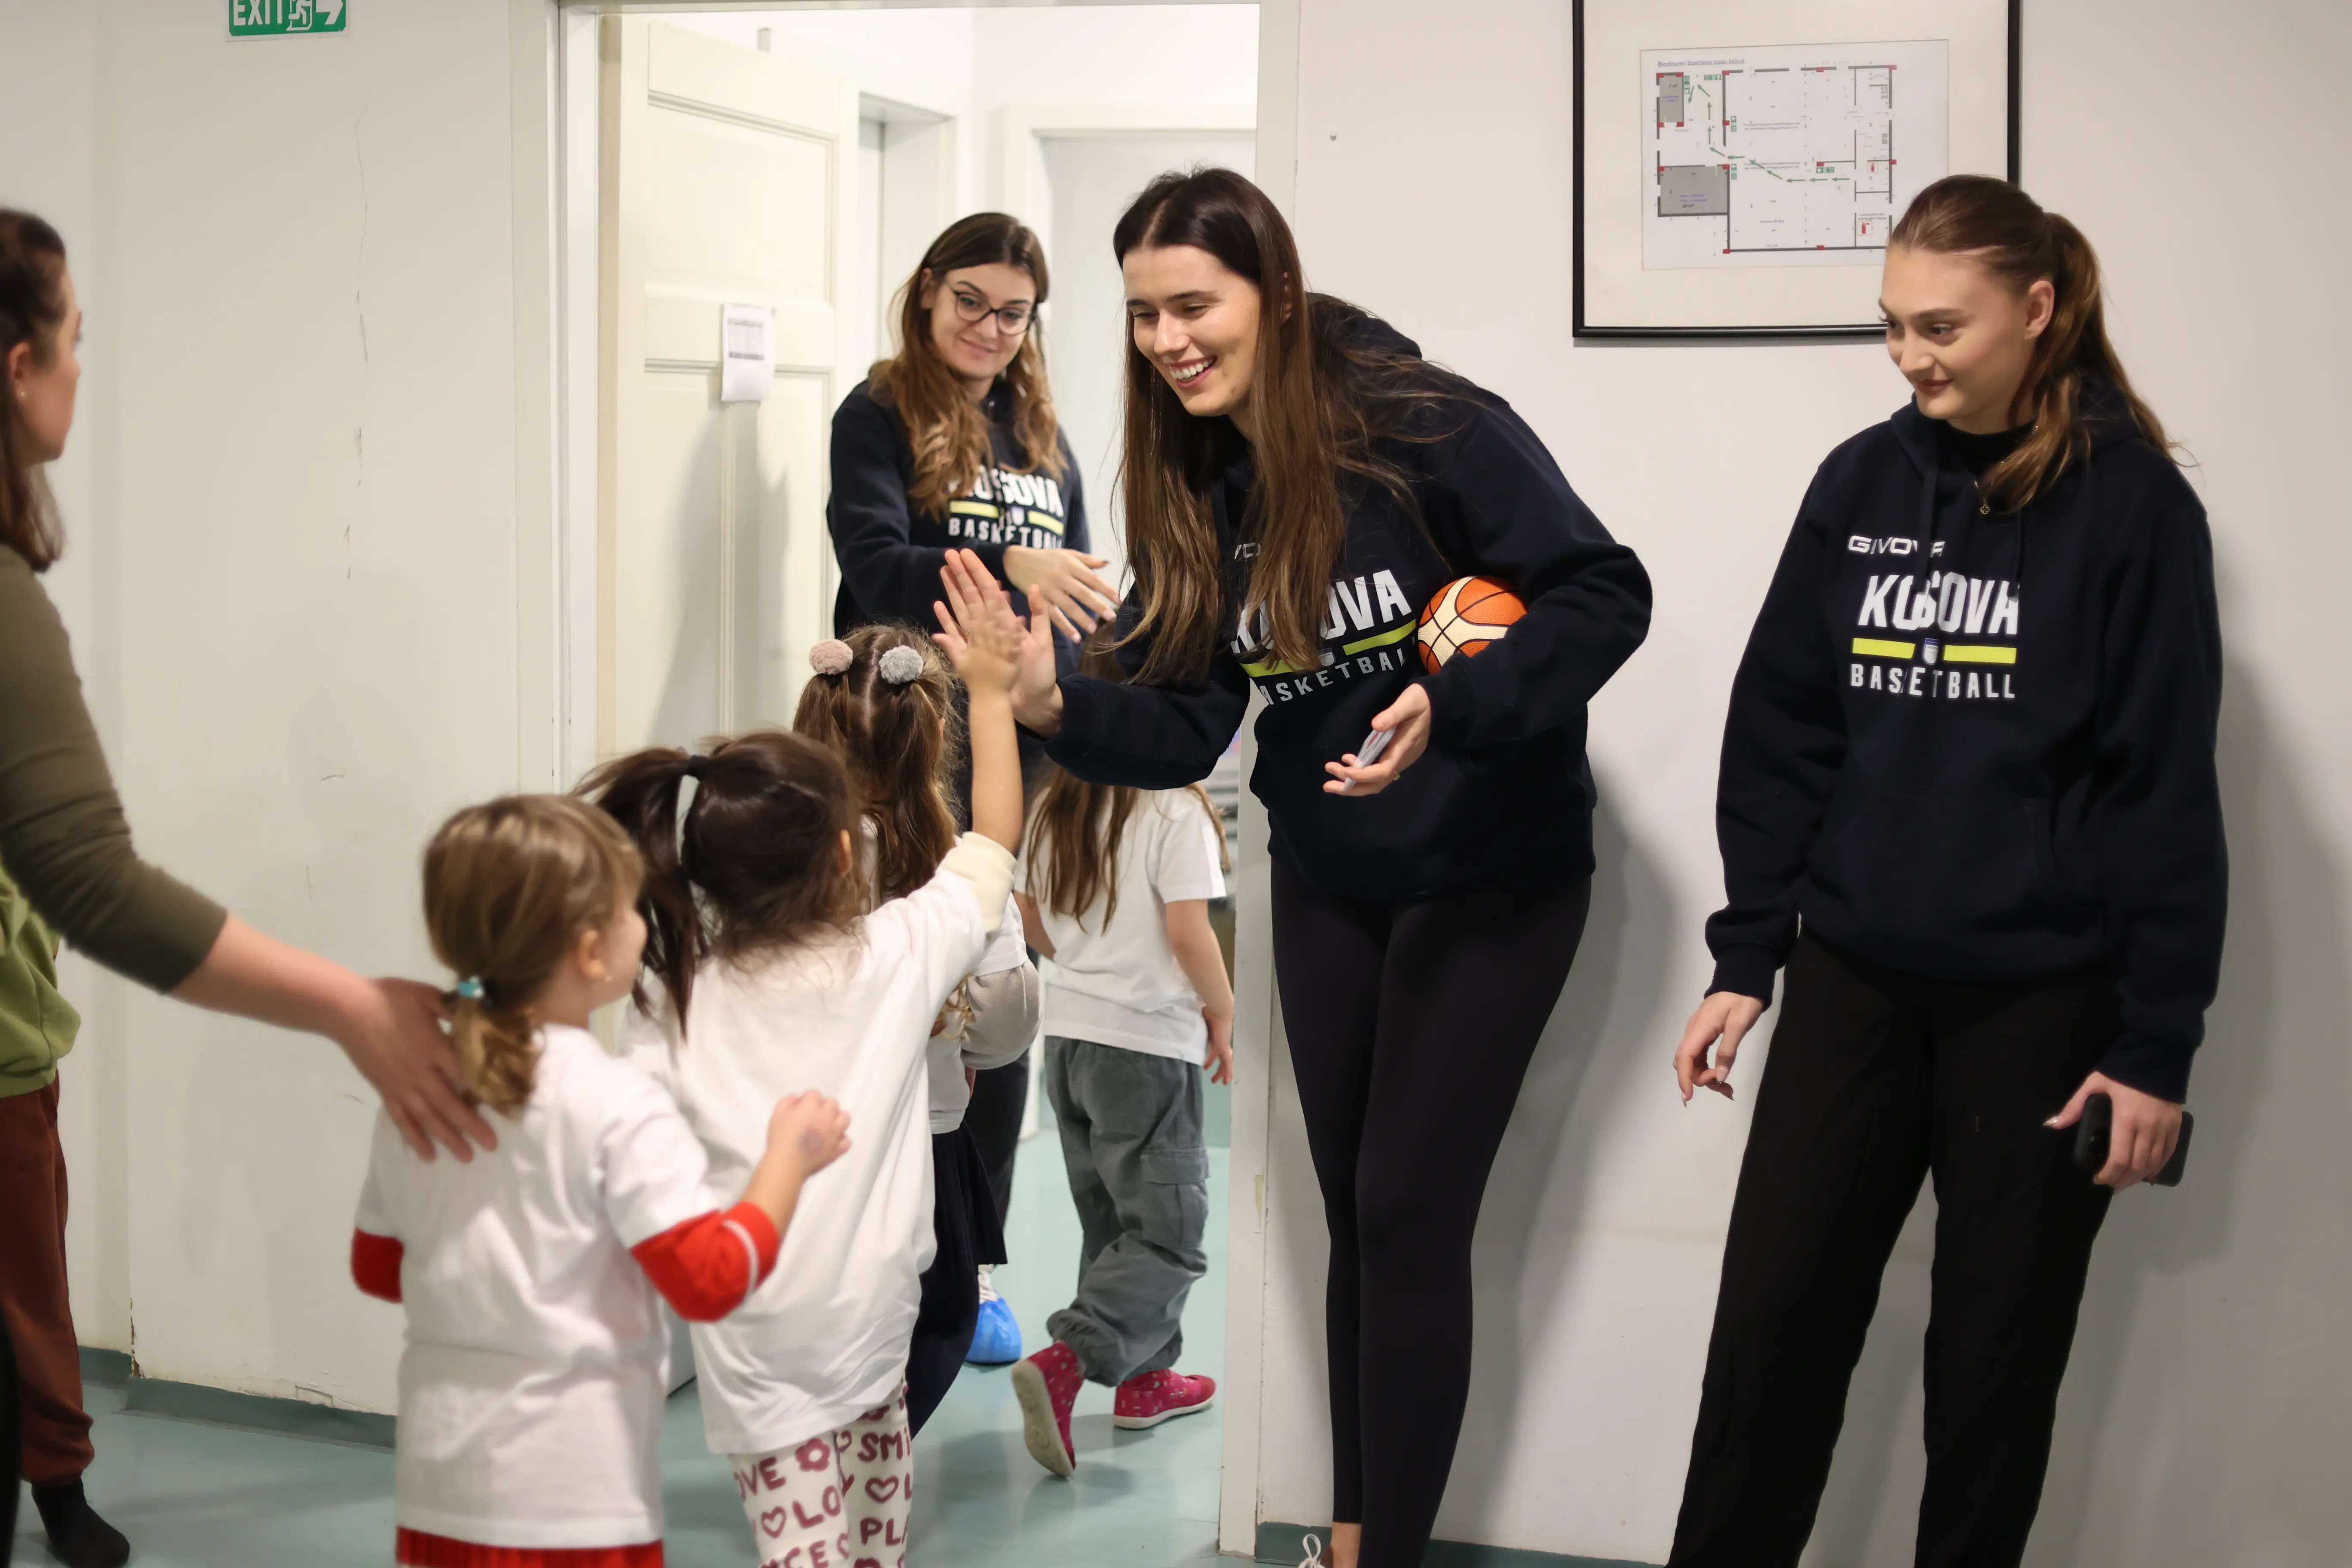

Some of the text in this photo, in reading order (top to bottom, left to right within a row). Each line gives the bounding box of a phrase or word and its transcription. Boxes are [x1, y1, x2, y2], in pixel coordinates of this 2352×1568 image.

[233, 0, 282, 25] EXIT
[1259, 636, 1415, 705] ASKETBAL
[1851, 664, 2015, 699] BASETBALL
